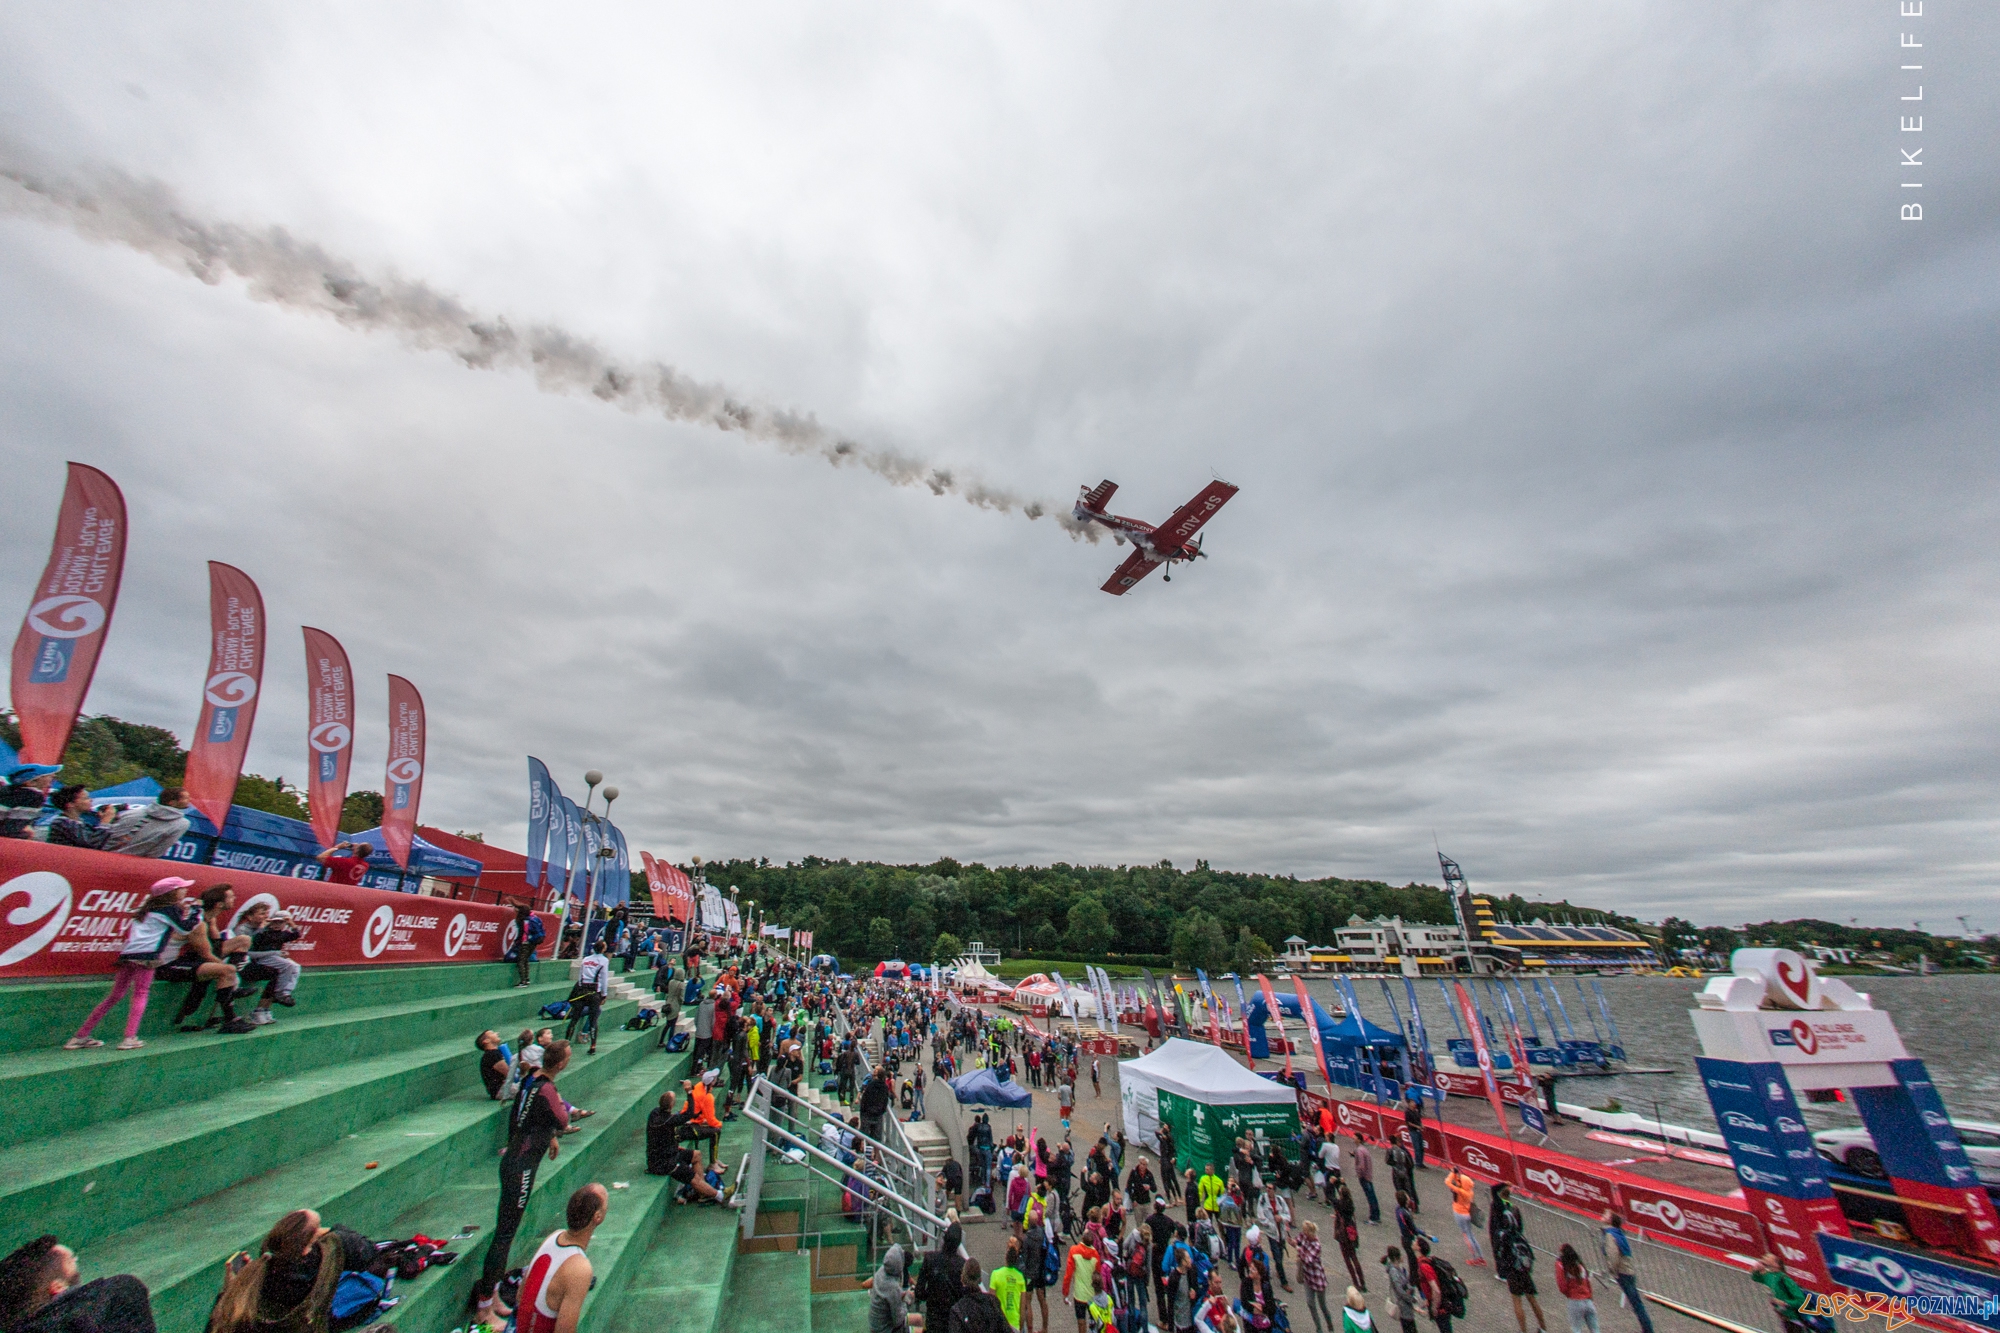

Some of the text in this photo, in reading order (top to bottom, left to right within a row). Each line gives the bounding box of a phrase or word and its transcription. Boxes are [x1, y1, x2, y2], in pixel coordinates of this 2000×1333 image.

[212, 849, 288, 874] SHIMANO
[286, 905, 353, 924] CHALLENGE
[394, 914, 439, 929] CHALLENGE
[61, 916, 132, 937] FAMILY
[467, 920, 499, 932] CHALLENGE
[1467, 1152, 1500, 1174] Enea
